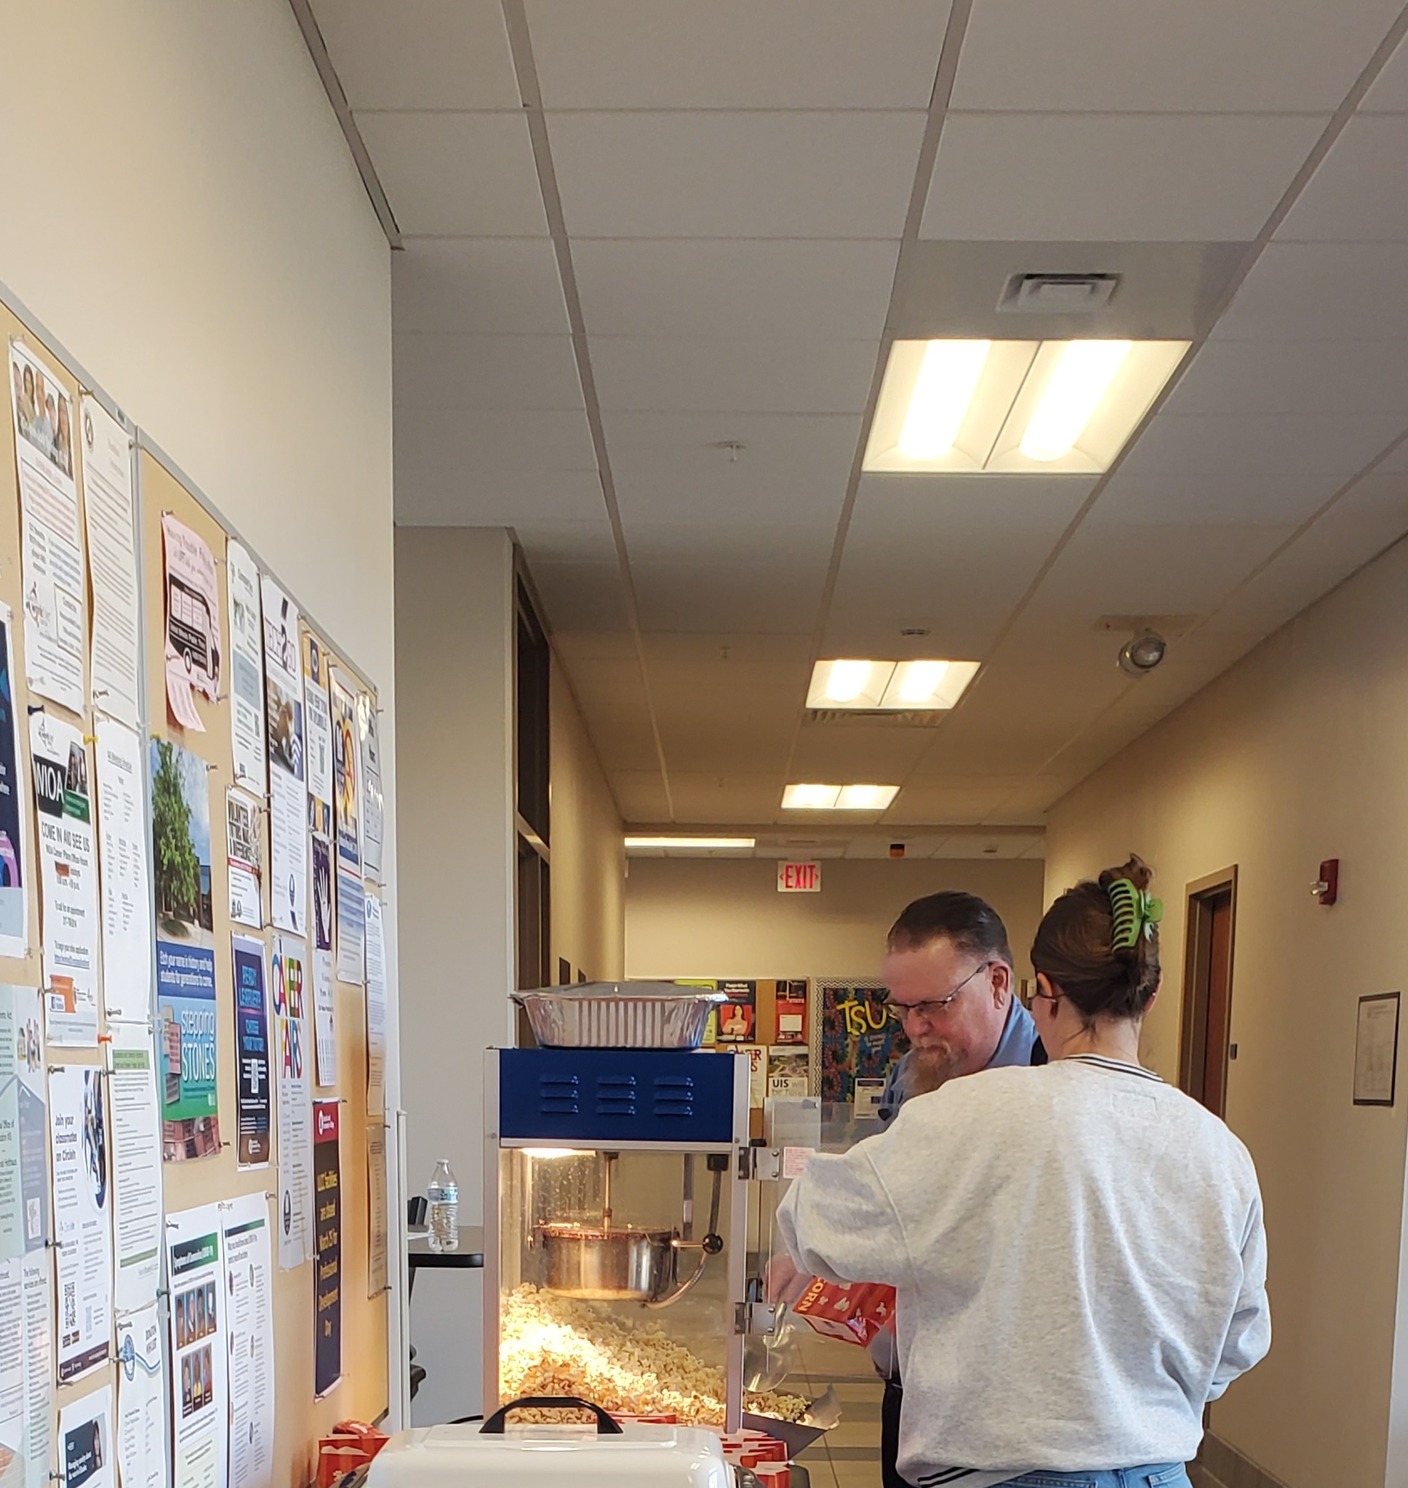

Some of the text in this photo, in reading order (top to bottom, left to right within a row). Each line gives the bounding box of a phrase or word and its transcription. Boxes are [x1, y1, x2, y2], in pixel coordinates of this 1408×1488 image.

[785, 864, 816, 889] EXIT
[181, 1007, 215, 1042] stepping
[836, 1000, 888, 1034] TSU
[182, 1043, 215, 1083] STONES
[772, 1079, 789, 1088] UIS
